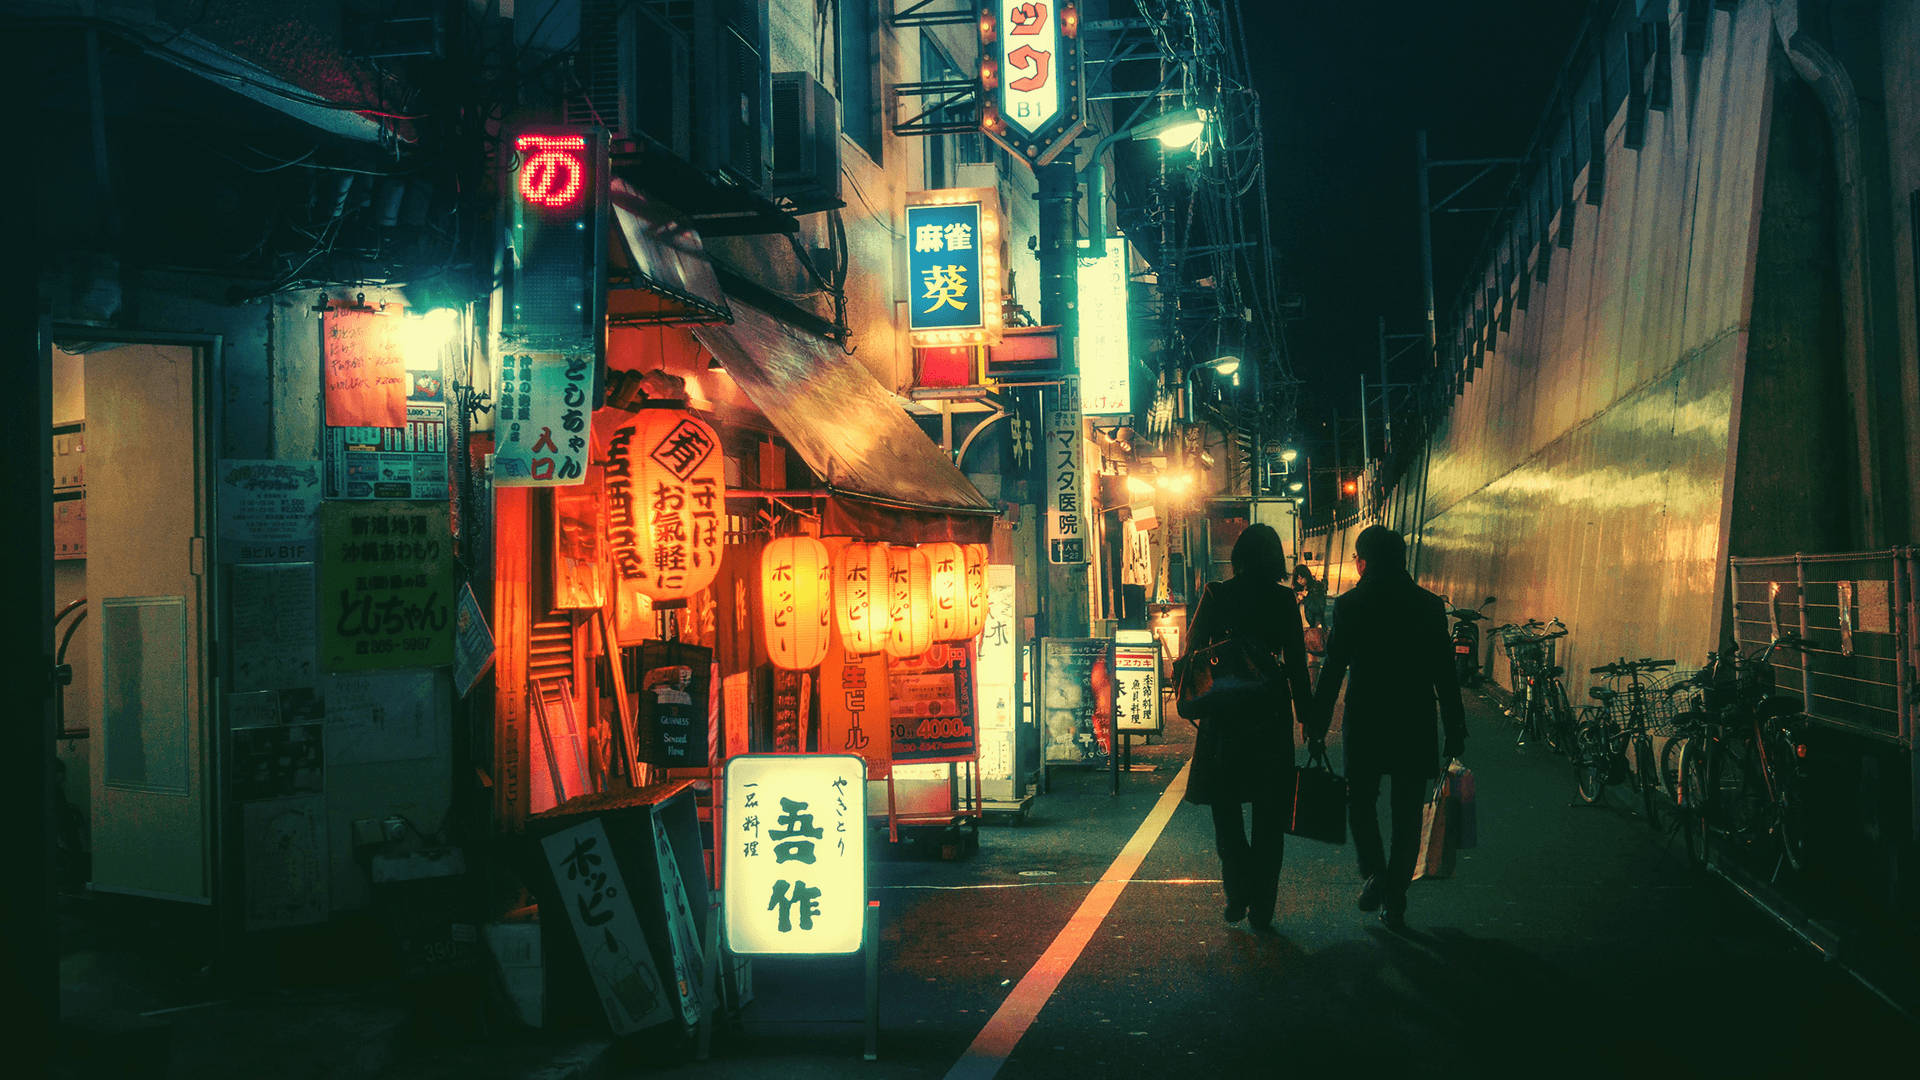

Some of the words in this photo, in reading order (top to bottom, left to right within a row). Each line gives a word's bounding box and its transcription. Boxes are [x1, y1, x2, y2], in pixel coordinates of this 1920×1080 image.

[1017, 102, 1042, 118] B1
[915, 223, 972, 252] 麻雀
[921, 264, 969, 314] 葵
[531, 426, 559, 481] 入口
[558, 357, 588, 480] としちゃん
[606, 424, 646, 581] 居酒屋
[337, 588, 448, 638] としちゃん
[772, 560, 793, 653] ホッピー
[847, 562, 869, 642] ホッピー
[742, 783, 761, 858] 一品料理
[832, 775, 848, 857] やきとり
[559, 836, 619, 955] ホッピー
[767, 796, 824, 933] 吾作
